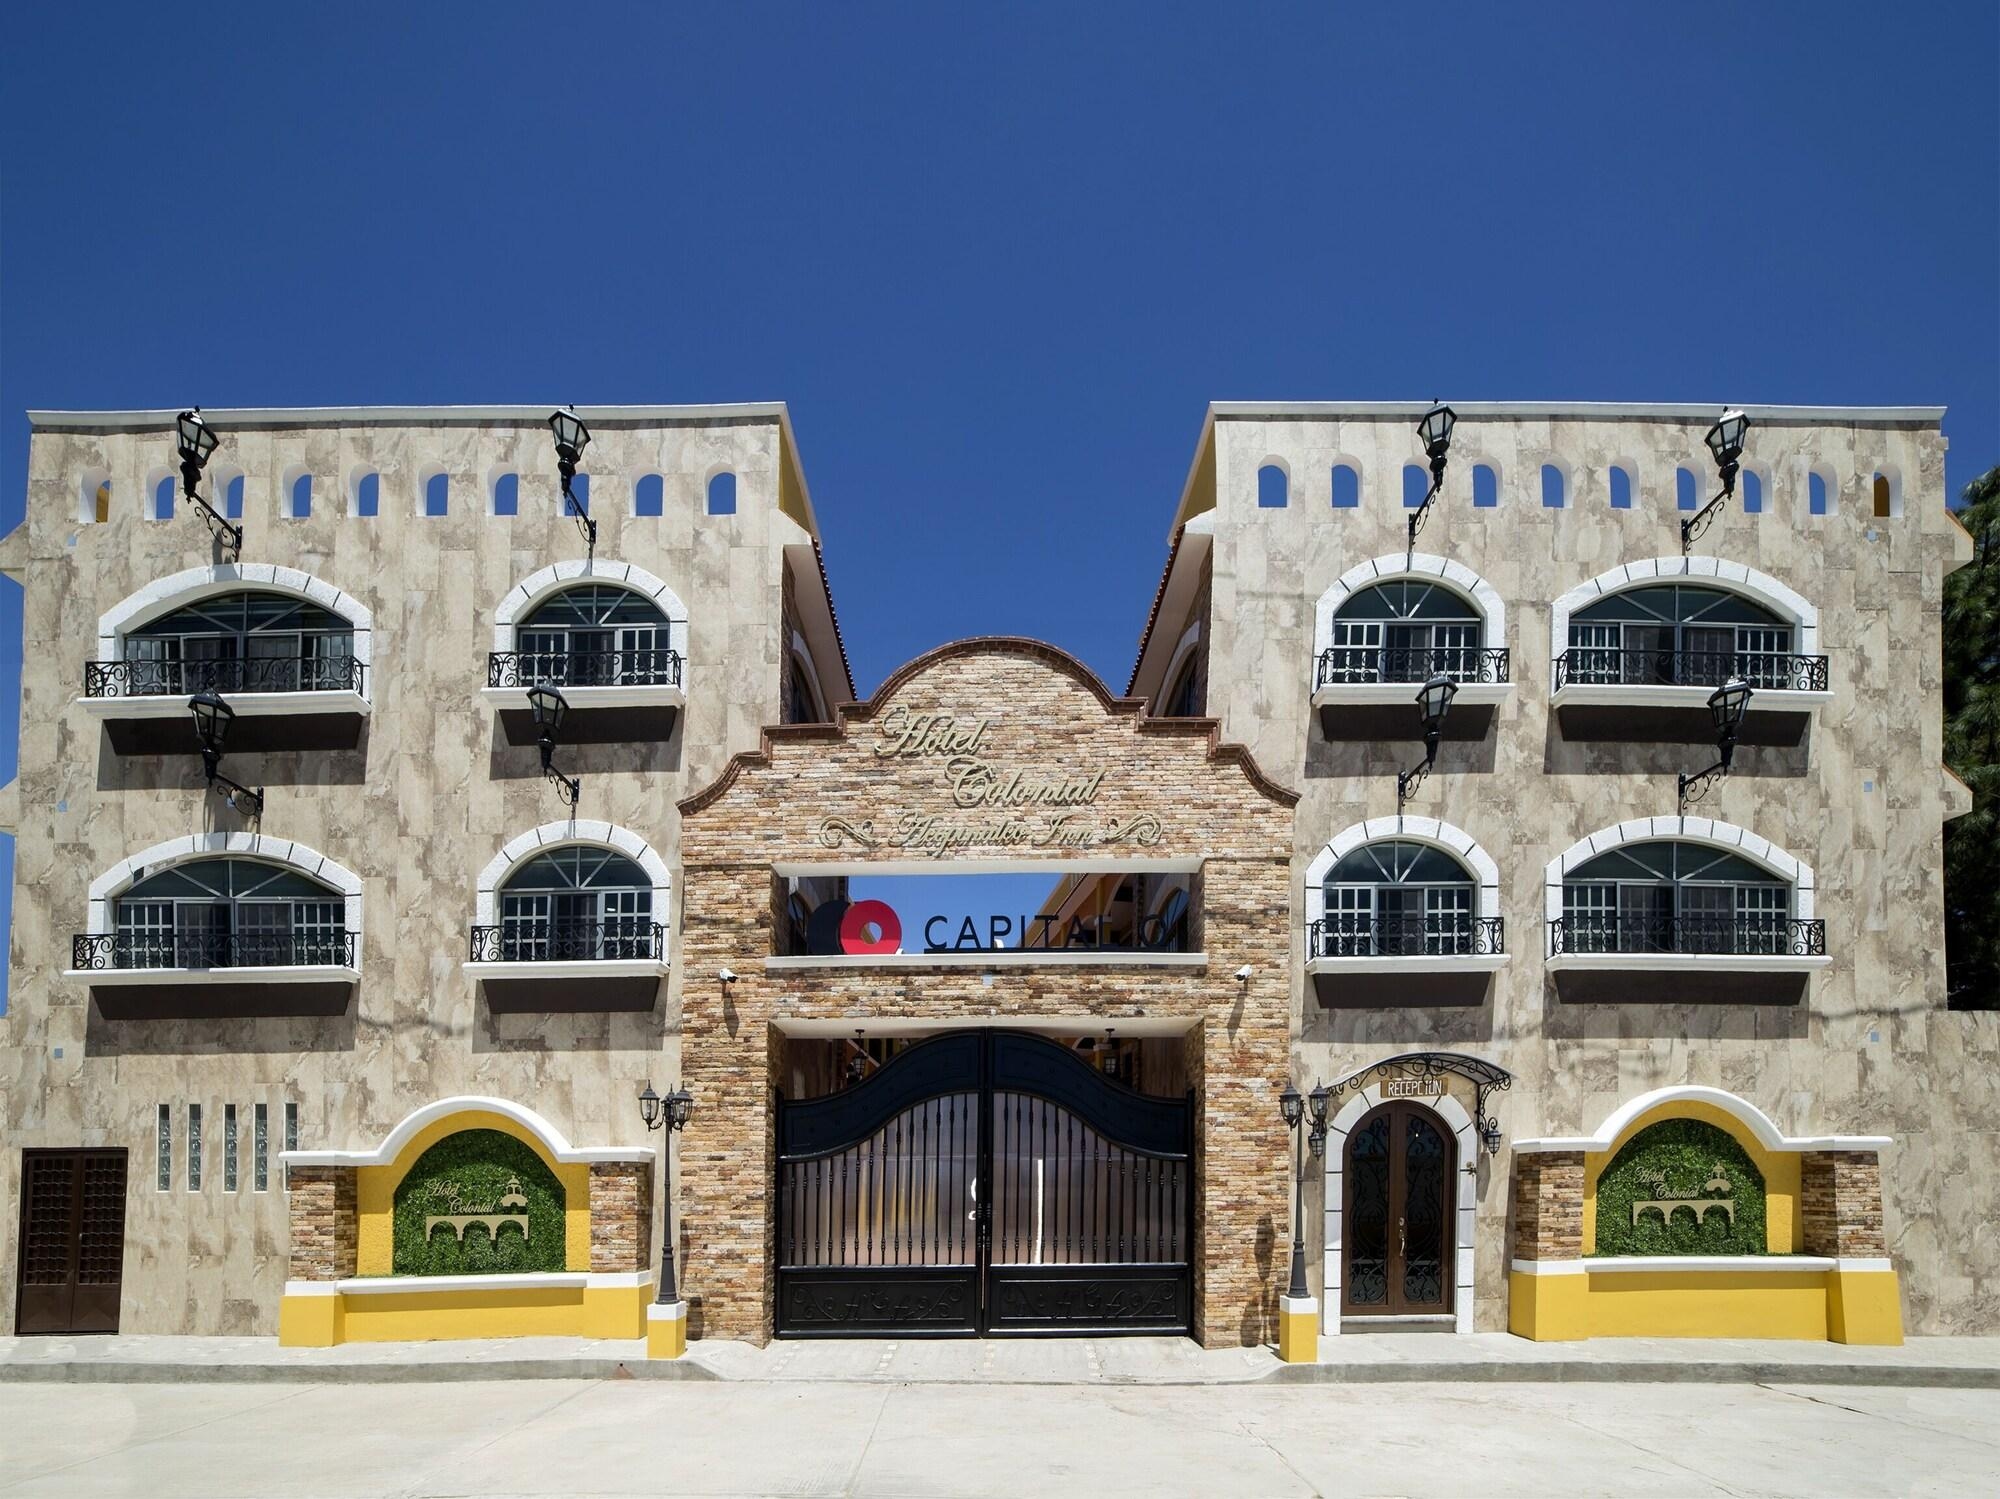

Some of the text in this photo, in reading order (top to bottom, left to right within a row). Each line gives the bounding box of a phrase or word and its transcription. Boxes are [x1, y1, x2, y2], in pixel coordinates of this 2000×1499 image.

[876, 704, 988, 755] Hotel
[945, 754, 1106, 806] Colonial
[1032, 814, 1094, 846] Inn
[924, 914, 1168, 949] CAPITAL O
[1634, 1167, 1666, 1183] Hotel
[427, 1179, 461, 1197] Hotel
[1653, 1182, 1700, 1199] Colonial
[447, 1196, 497, 1214] Colonial
